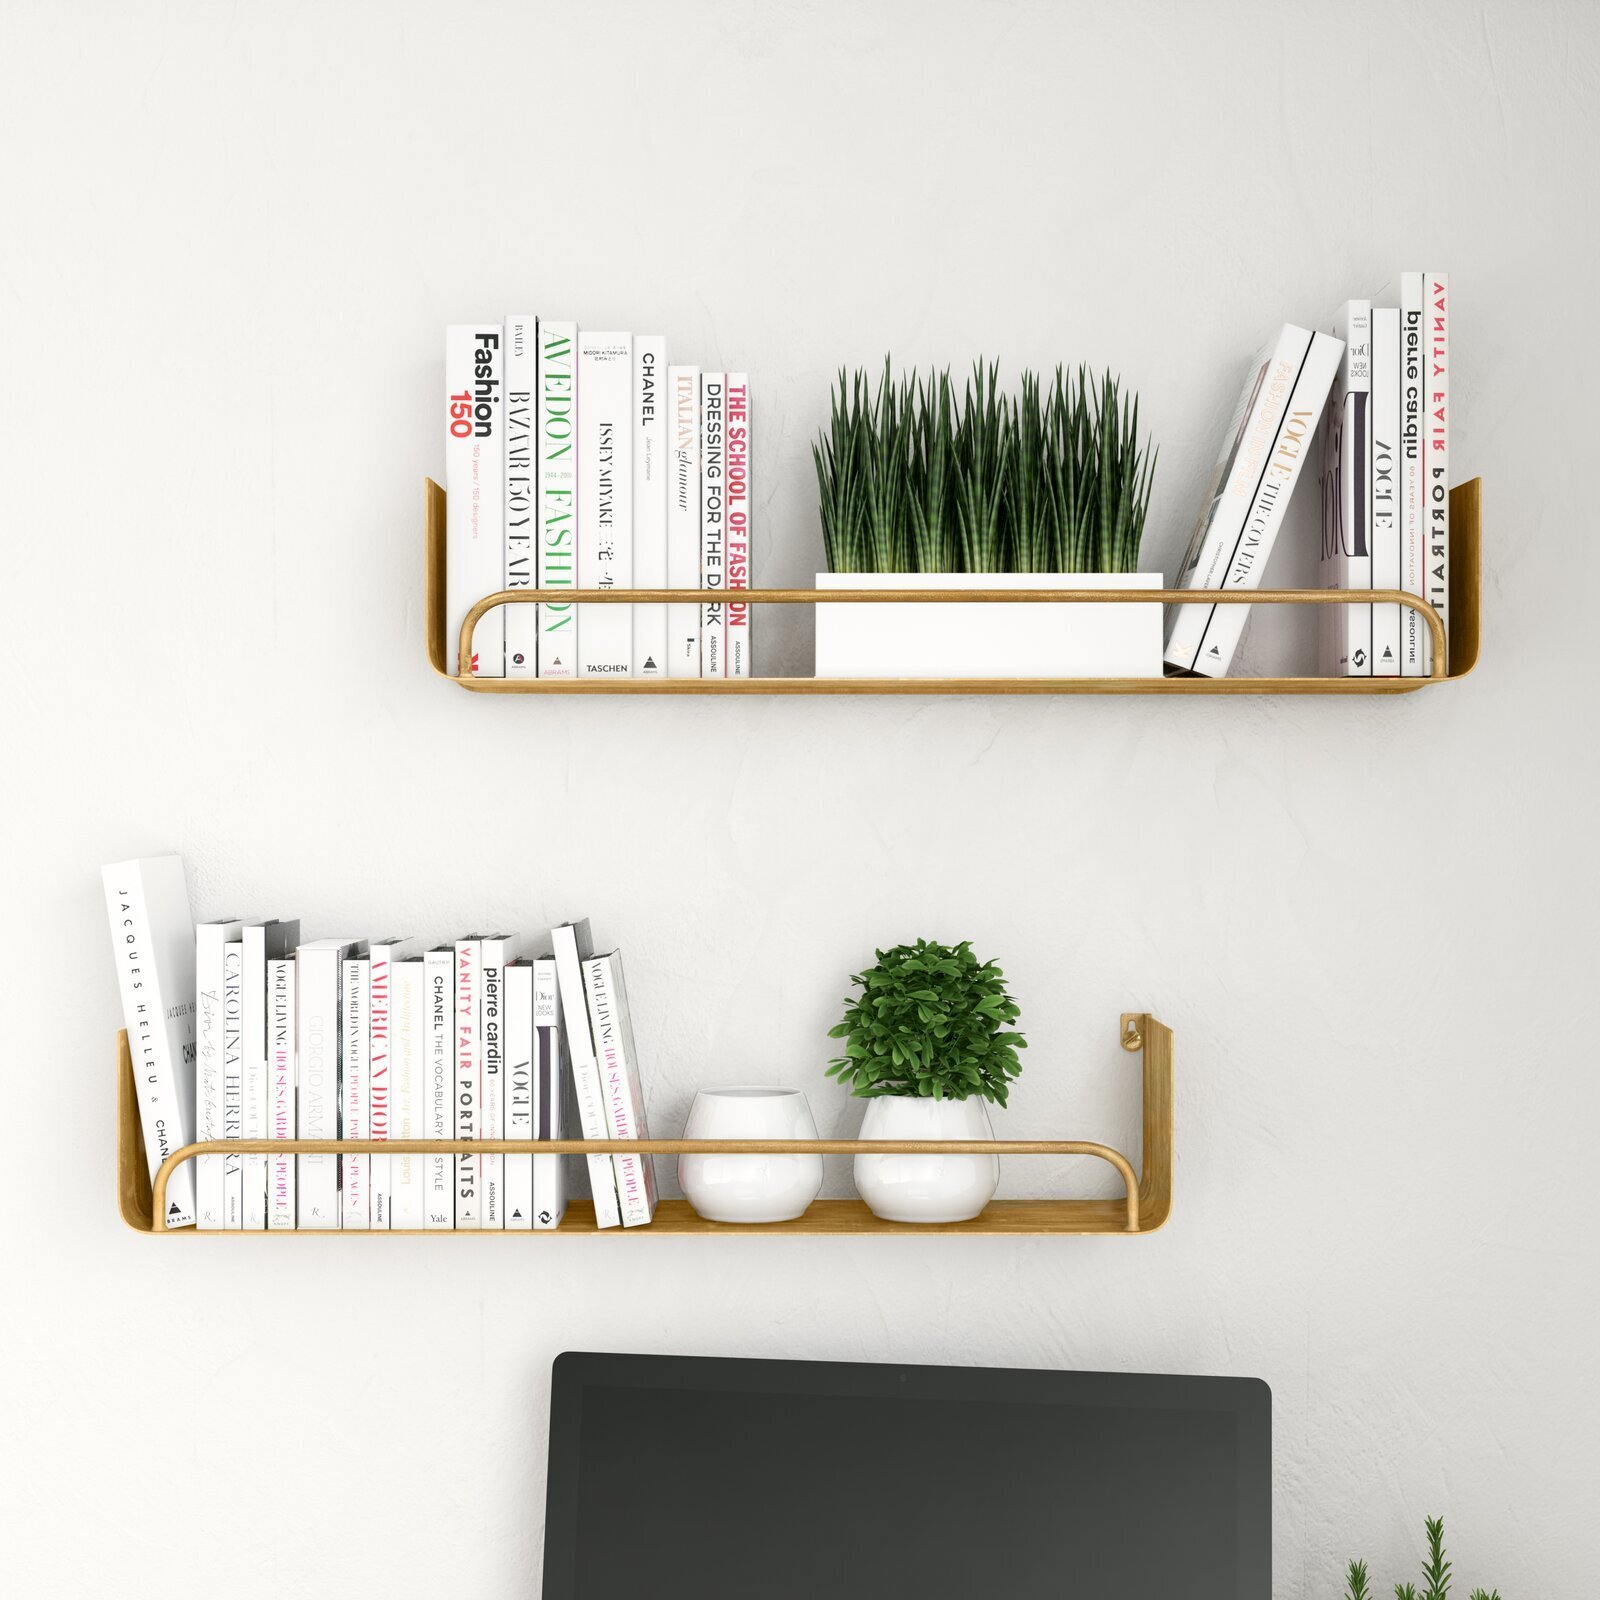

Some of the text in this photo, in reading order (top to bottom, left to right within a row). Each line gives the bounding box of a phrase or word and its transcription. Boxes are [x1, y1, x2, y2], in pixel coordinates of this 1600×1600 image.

[474, 333, 500, 438] Fashion
[543, 329, 572, 461] AVEDON
[642, 352, 655, 427] CHANEL
[450, 389, 473, 439] 150
[508, 391, 531, 469] BAZAAR
[675, 375, 694, 512] ITALIAN glamour
[599, 422, 613, 528] ISSEY MIYAKE
[1233, 410, 1313, 586] VOGUE THE COVERS
[706, 383, 722, 626] DRESSING FOR THE DRK
[728, 384, 747, 627] THE SCHOOL OF FASHON
[586, 664, 628, 673] TASCHEN
[275, 963, 287, 1002] VOGUE
[350, 964, 359, 984] THE
[459, 947, 472, 1016] VANITY
[536, 991, 555, 1001] Dior
[591, 962, 608, 1002] VOGUE
[118, 890, 143, 989] JACQUES
[136, 1003, 158, 1084] HELLEU
[155, 1119, 170, 1164] CHAN
[225, 952, 240, 1065] CAROLINA
[275, 1004, 287, 1046] LIVING
[350, 986, 359, 1023] WORLD
[433, 975, 444, 1031] CHANEL
[483, 967, 502, 1075] pierre cardin
[596, 1002, 614, 1045] LIVING
[308, 1015, 324, 1087] GIORGIO
[350, 1038, 359, 1072] VOGUE
[371, 961, 388, 1141] AMERICAN DIOR
[434, 1034, 444, 1055] THE
[459, 1026, 473, 1069] FAIR
[350, 1075, 359, 1114] PEOPLE
[434, 1058, 444, 1136] VOCABULARY
[512, 1060, 530, 1125] VOGUE
[350, 1119, 359, 1163] PARS
[276, 1162, 287, 1210] PEOPLE
[350, 1166, 359, 1206] PLACES
[434, 1157, 444, 1191] STYLE
[621, 1157, 640, 1207] PEOPLE
[429, 1214, 448, 1223] Yale
[488, 1181, 496, 1222] ASSOULINE
